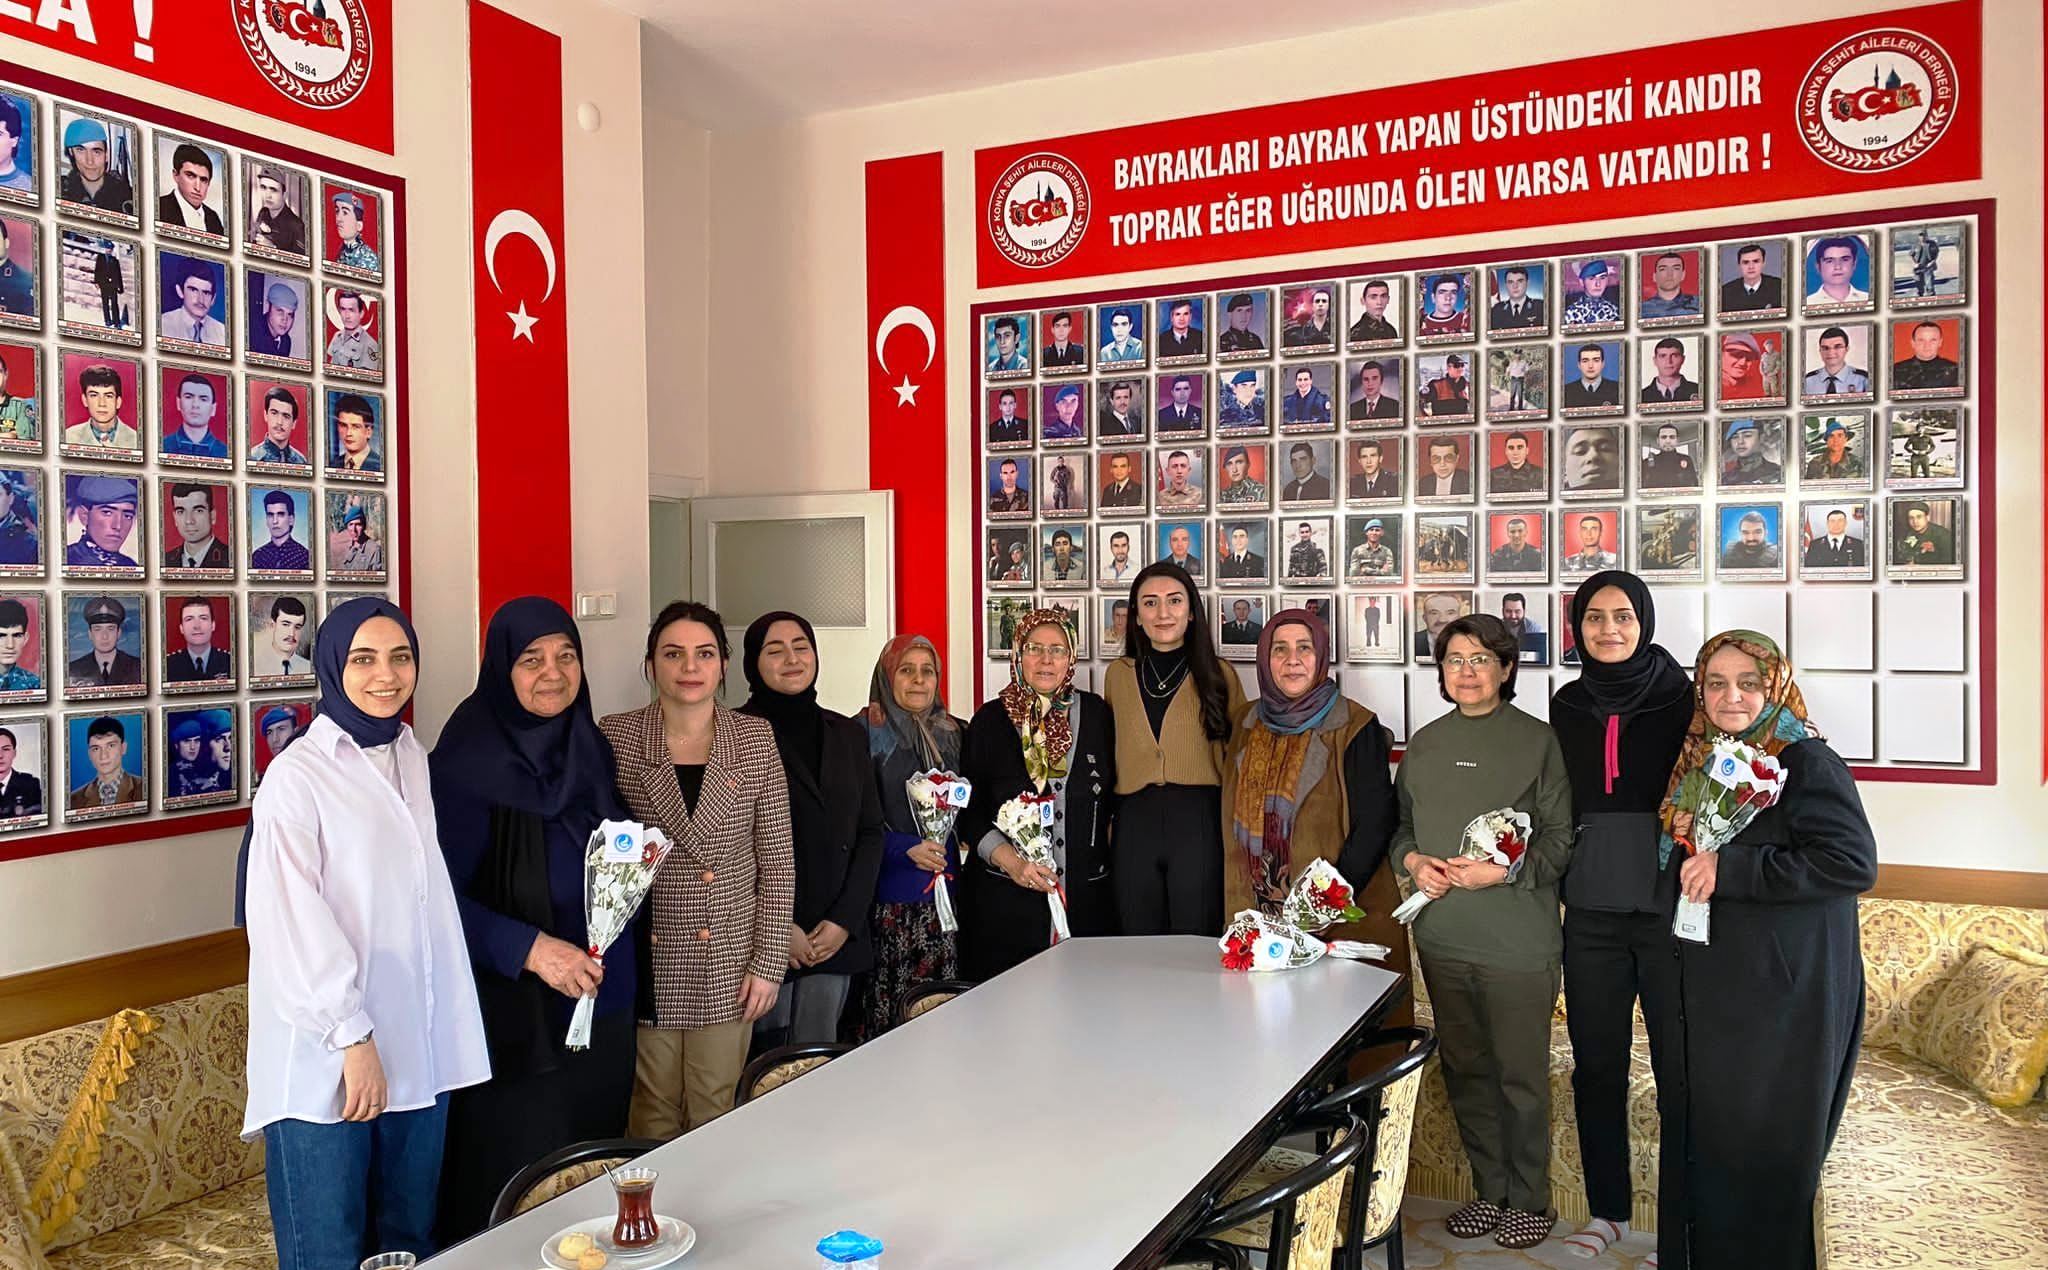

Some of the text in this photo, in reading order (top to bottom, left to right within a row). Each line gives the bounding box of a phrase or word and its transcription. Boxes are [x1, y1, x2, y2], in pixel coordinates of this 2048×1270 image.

[294, 61, 317, 77] 1994
[1804, 37, 1952, 116] KONYA ŞEHİT AİLELERİ DERNEĞİ
[1115, 69, 1761, 190] BAYRAKLARI BAYRAK YAPAN ÜSTÜNDEKİ KANDIR
[1863, 135, 1888, 146] 1994
[993, 189, 1006, 222] KONYA
[1110, 133, 1770, 246] TOPRAK EĞER UĞRUNDA ÖLEN VARSA VATANDIR !
[1031, 238, 1047, 247] 1994
